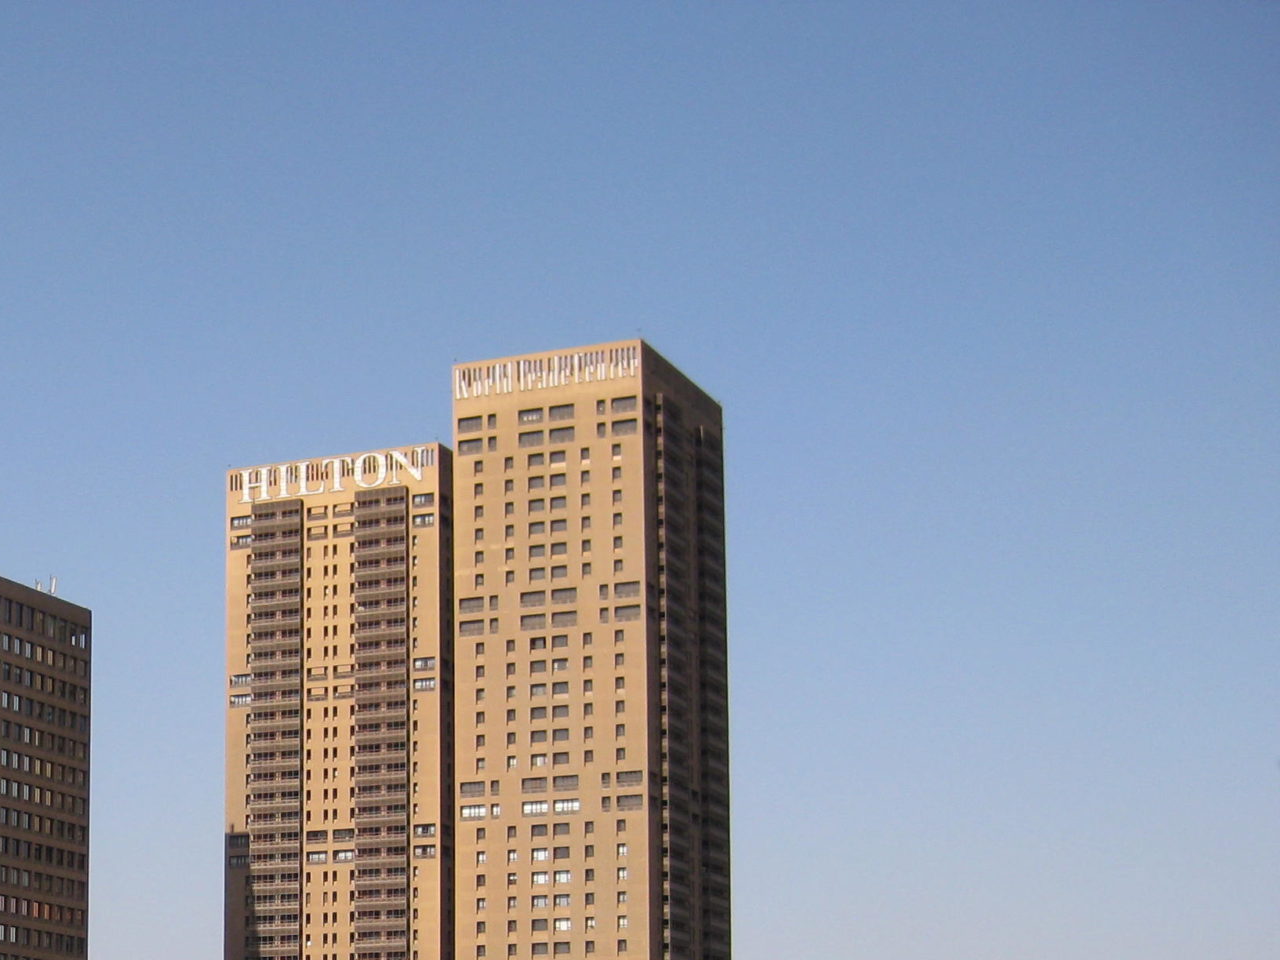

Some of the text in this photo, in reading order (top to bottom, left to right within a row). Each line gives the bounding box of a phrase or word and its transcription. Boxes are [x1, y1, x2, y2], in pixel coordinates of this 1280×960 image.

[455, 361, 512, 400] World
[519, 355, 574, 391] Trade
[239, 446, 427, 504] HILTON
